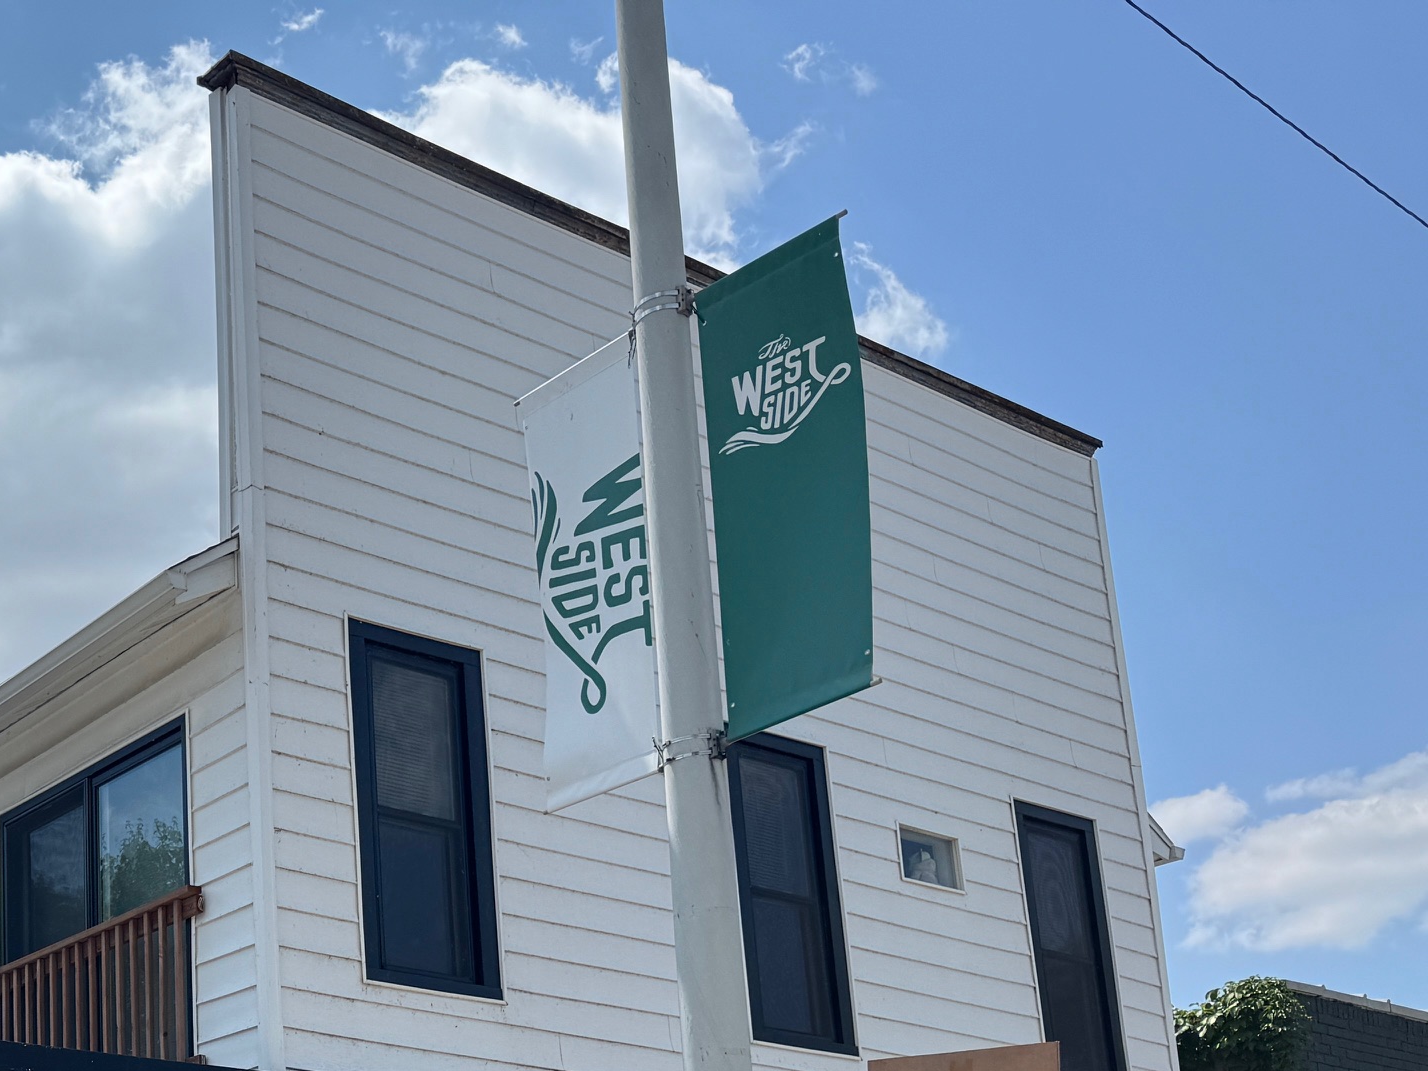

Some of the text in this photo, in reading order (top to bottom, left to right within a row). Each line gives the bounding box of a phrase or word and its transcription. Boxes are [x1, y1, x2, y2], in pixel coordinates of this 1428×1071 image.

[731, 336, 827, 417] WEST
[758, 333, 792, 360] The
[760, 379, 812, 430] SIDE
[548, 541, 601, 641] SIDE
[573, 453, 653, 665] WEST
